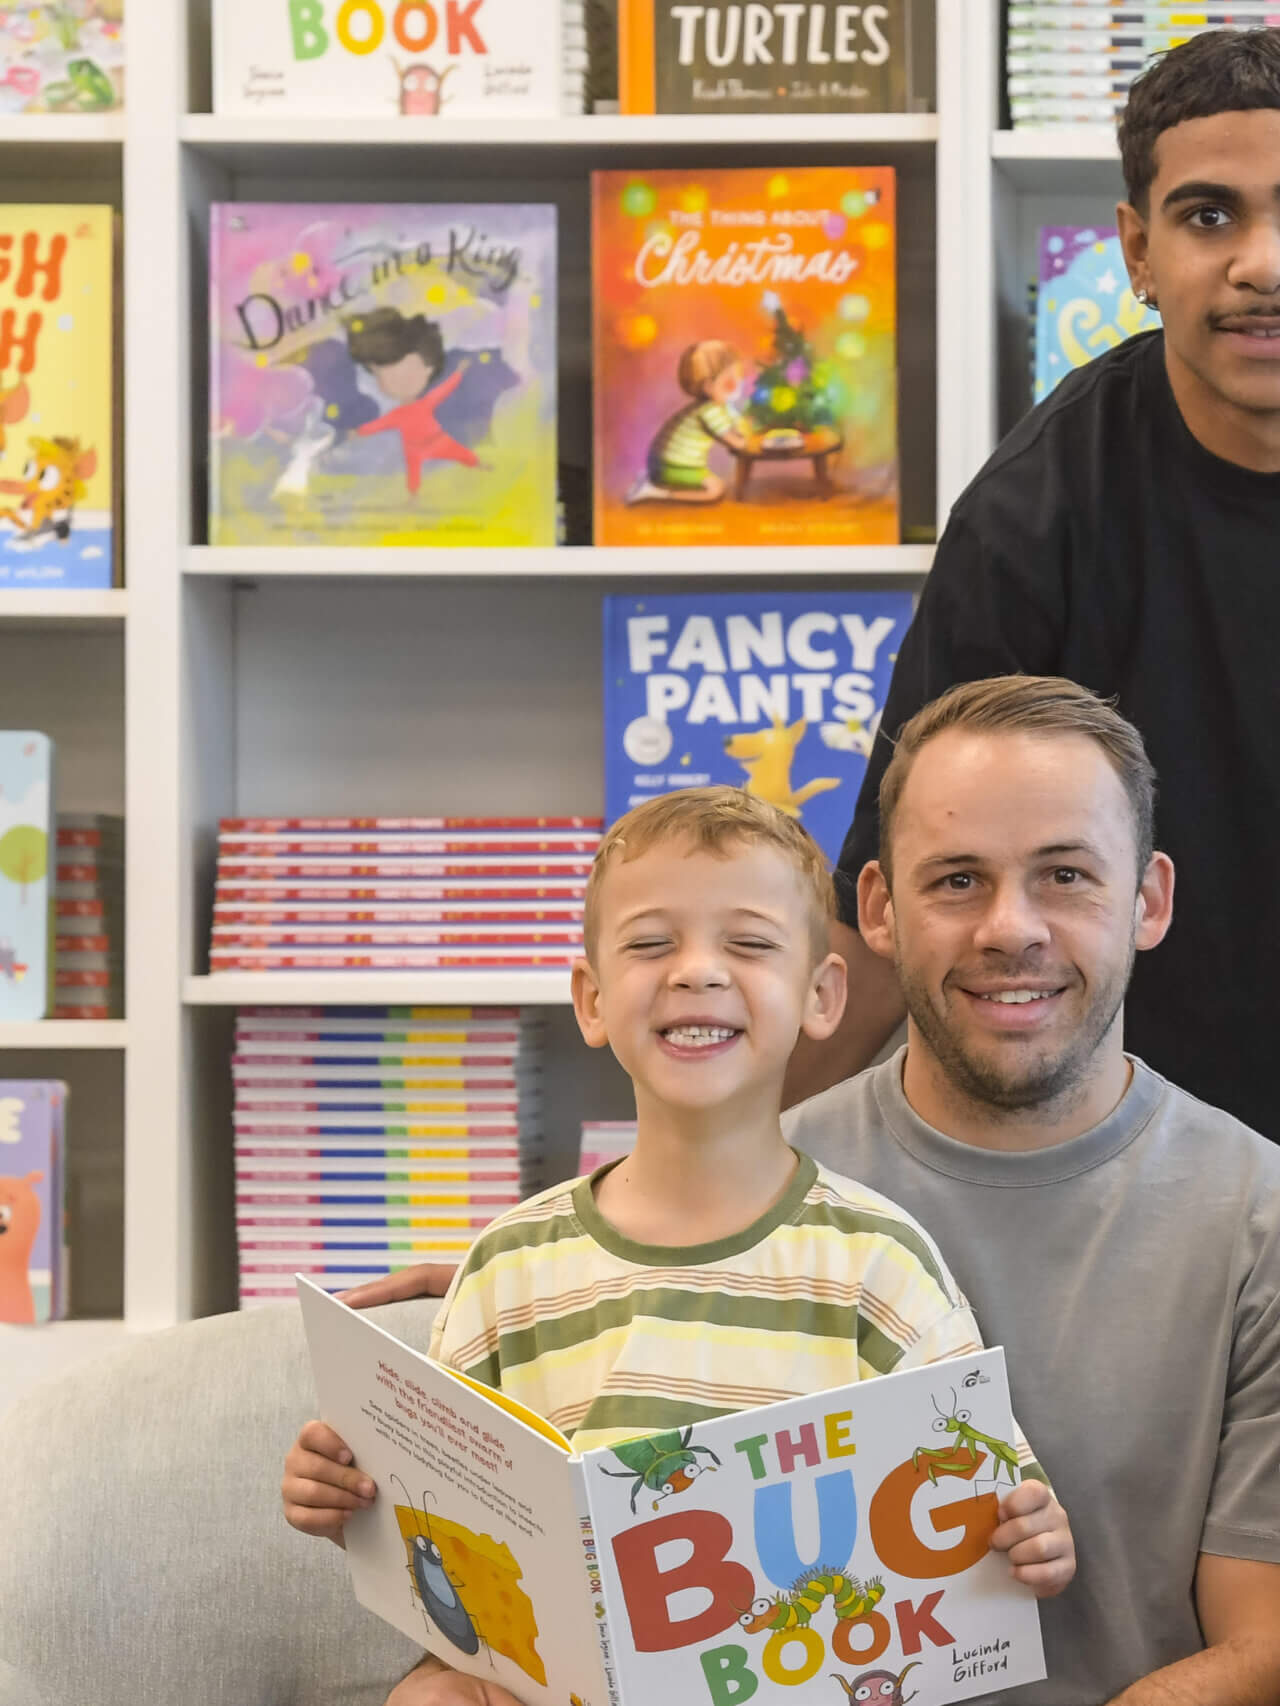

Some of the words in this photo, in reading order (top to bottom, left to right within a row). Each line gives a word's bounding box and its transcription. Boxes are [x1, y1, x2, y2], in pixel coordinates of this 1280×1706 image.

[287, 0, 488, 61] BOOK
[670, 3, 890, 66] TURTLES
[634, 230, 860, 288] Christmas
[626, 611, 896, 674] FANCY
[646, 672, 876, 725] PANTS
[399, 1386, 415, 1405] the
[459, 1416, 479, 1434] and
[734, 1410, 856, 1480] THE
[579, 1515, 593, 1535] THE
[582, 1539, 597, 1560] BUG
[611, 1446, 1002, 1653] BUG
[586, 1564, 602, 1594] BOOK
[699, 1590, 957, 1706] BOOK
[952, 1638, 1011, 1665] Lucinda
[953, 1655, 1008, 1682] Gifford
